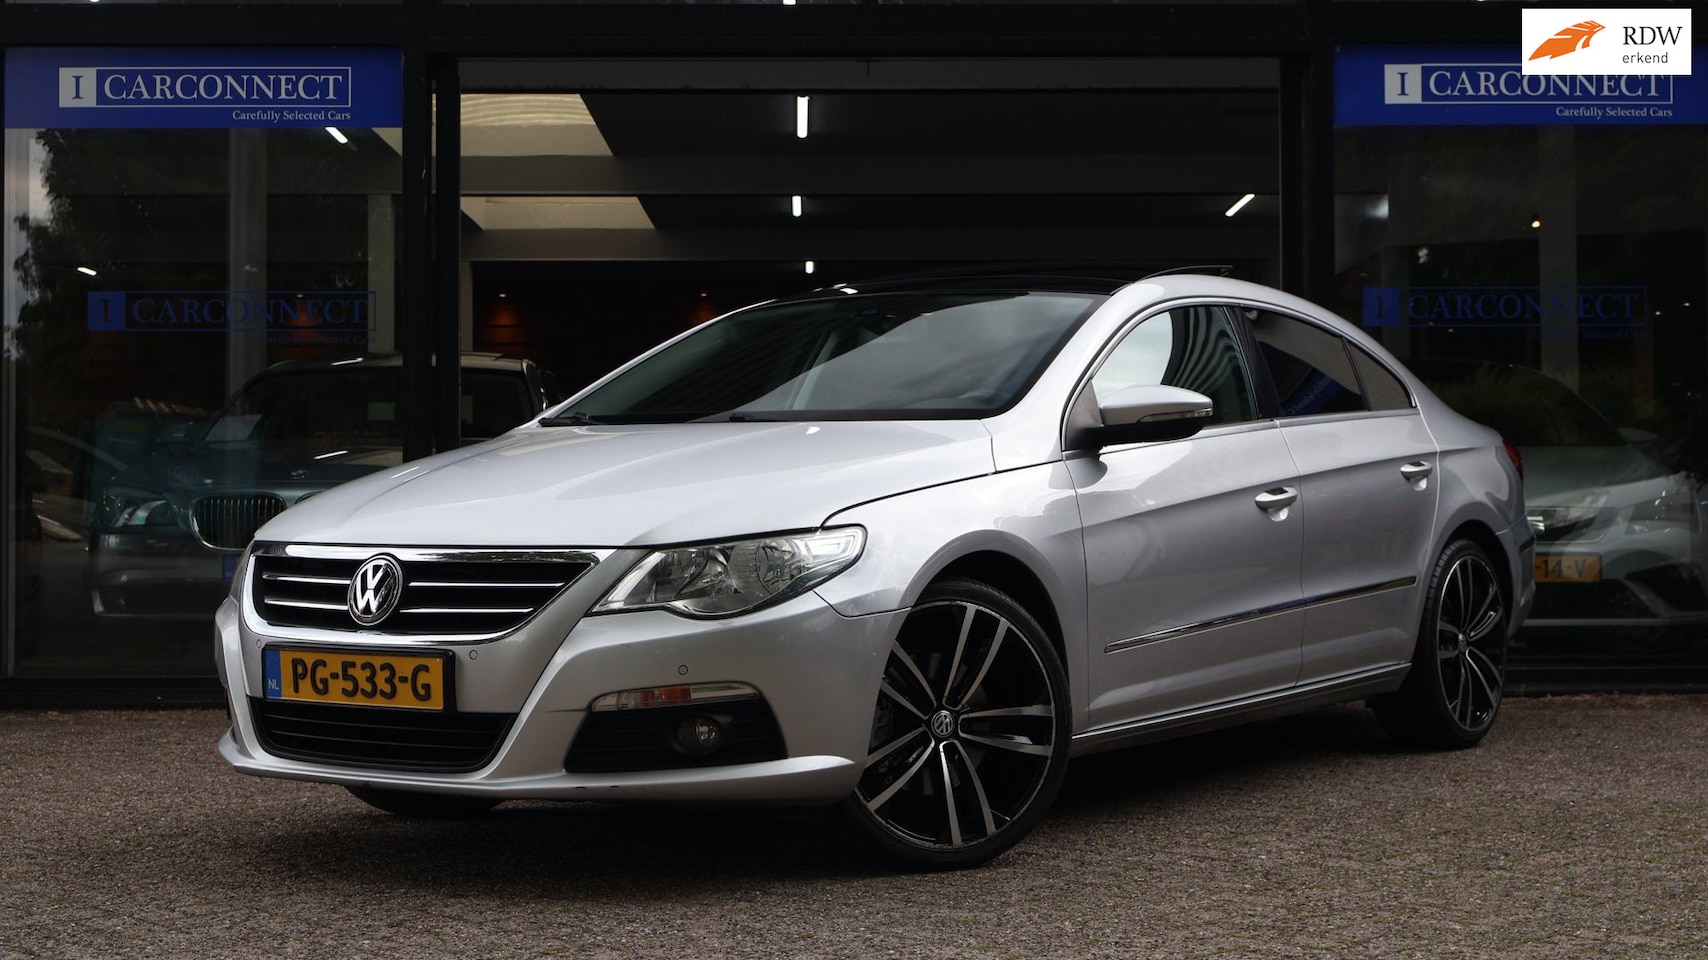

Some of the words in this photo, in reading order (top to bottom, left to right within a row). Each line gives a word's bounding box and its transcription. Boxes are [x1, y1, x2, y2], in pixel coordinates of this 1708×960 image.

[71, 74, 84, 100] I
[103, 73, 343, 101] CARCONNECT
[1397, 71, 1409, 97] I
[232, 110, 281, 123] Carefully
[283, 110, 325, 120] Selected
[327, 110, 351, 120] Cars
[1556, 106, 1604, 120] Carefully
[1606, 106, 1647, 117] Selected
[1649, 106, 1673, 117] Cars
[132, 297, 369, 325] CARCONNECT
[1407, 292, 1639, 320] CARCONNECT
[268, 679, 280, 691] NL
[291, 657, 432, 702] PG-533-G
